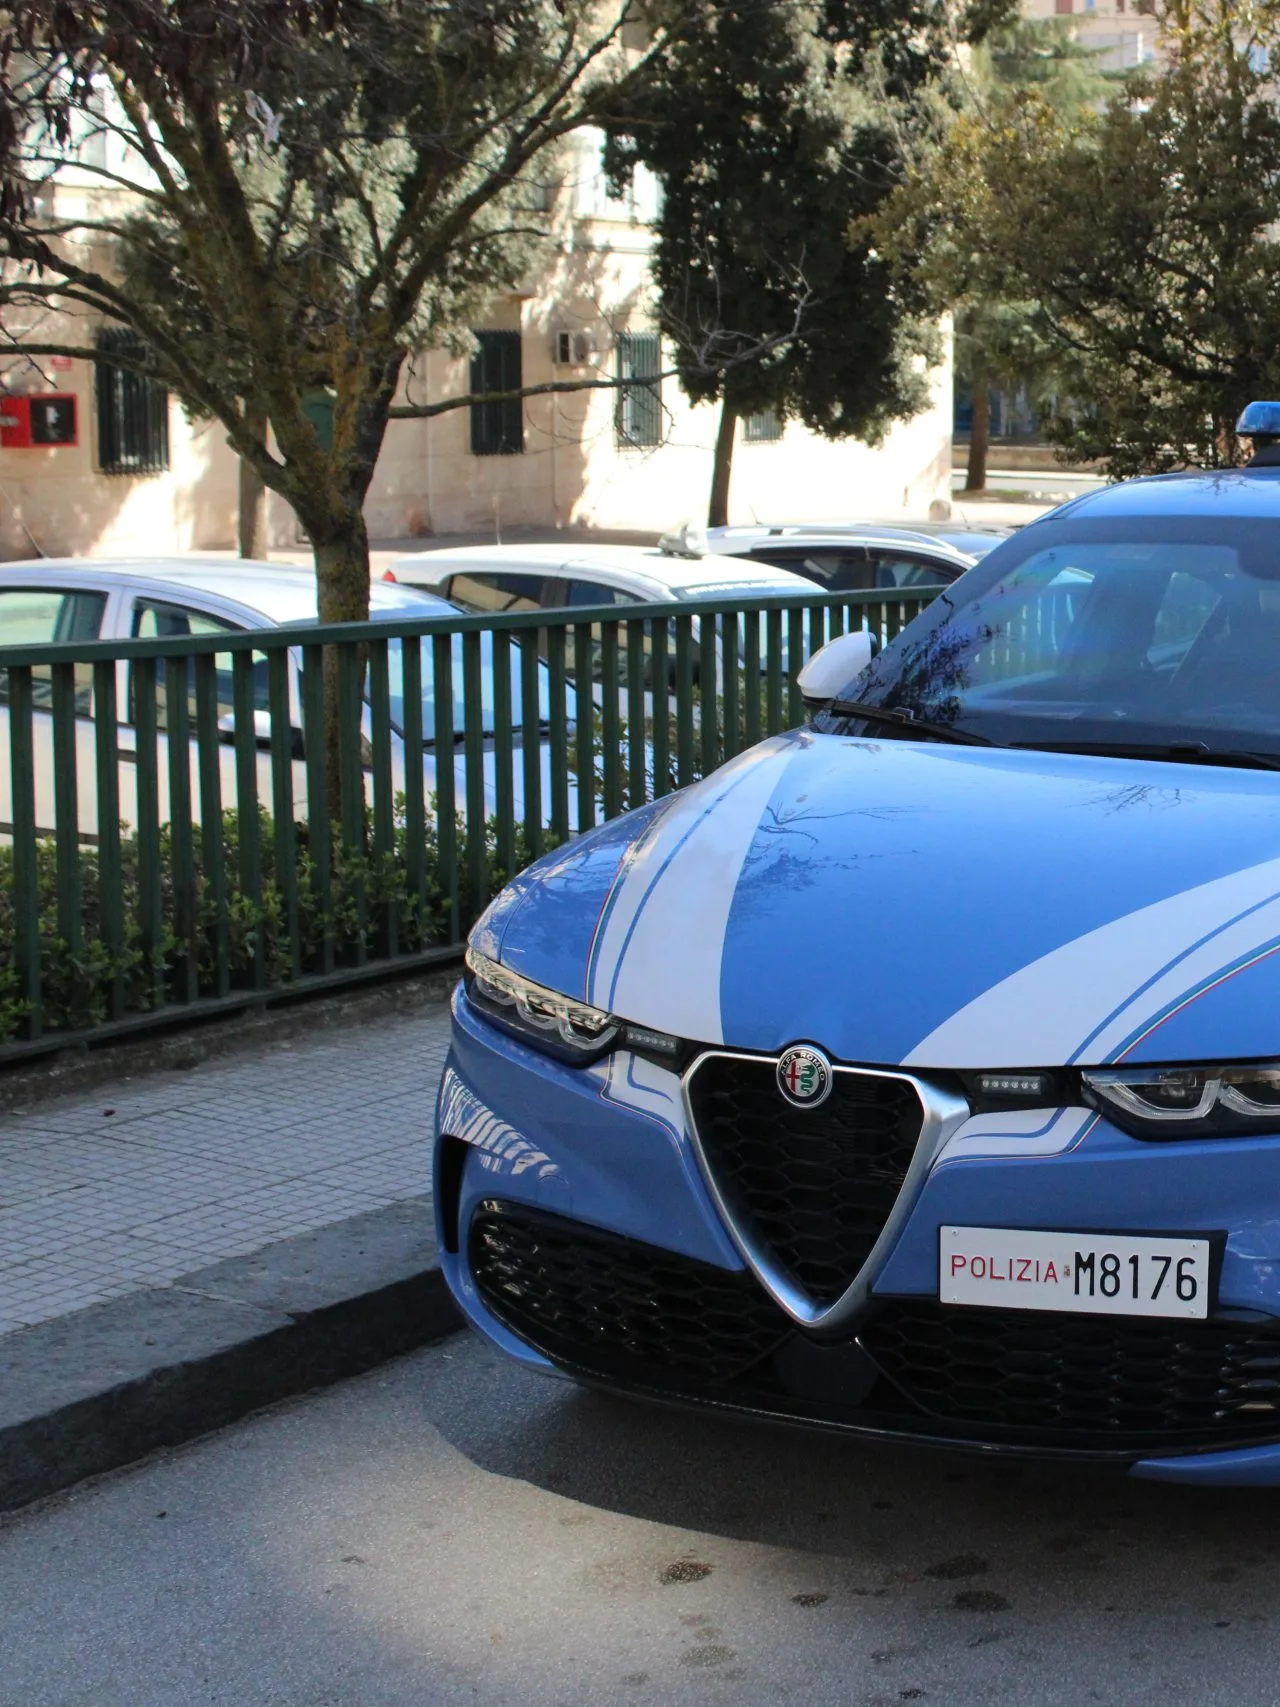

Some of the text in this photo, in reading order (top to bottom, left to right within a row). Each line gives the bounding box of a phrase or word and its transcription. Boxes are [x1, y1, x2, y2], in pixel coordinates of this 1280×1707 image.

[781, 1052, 824, 1080] ALFA ROMEO
[951, 1251, 1198, 1301] POLIZIA M8176
